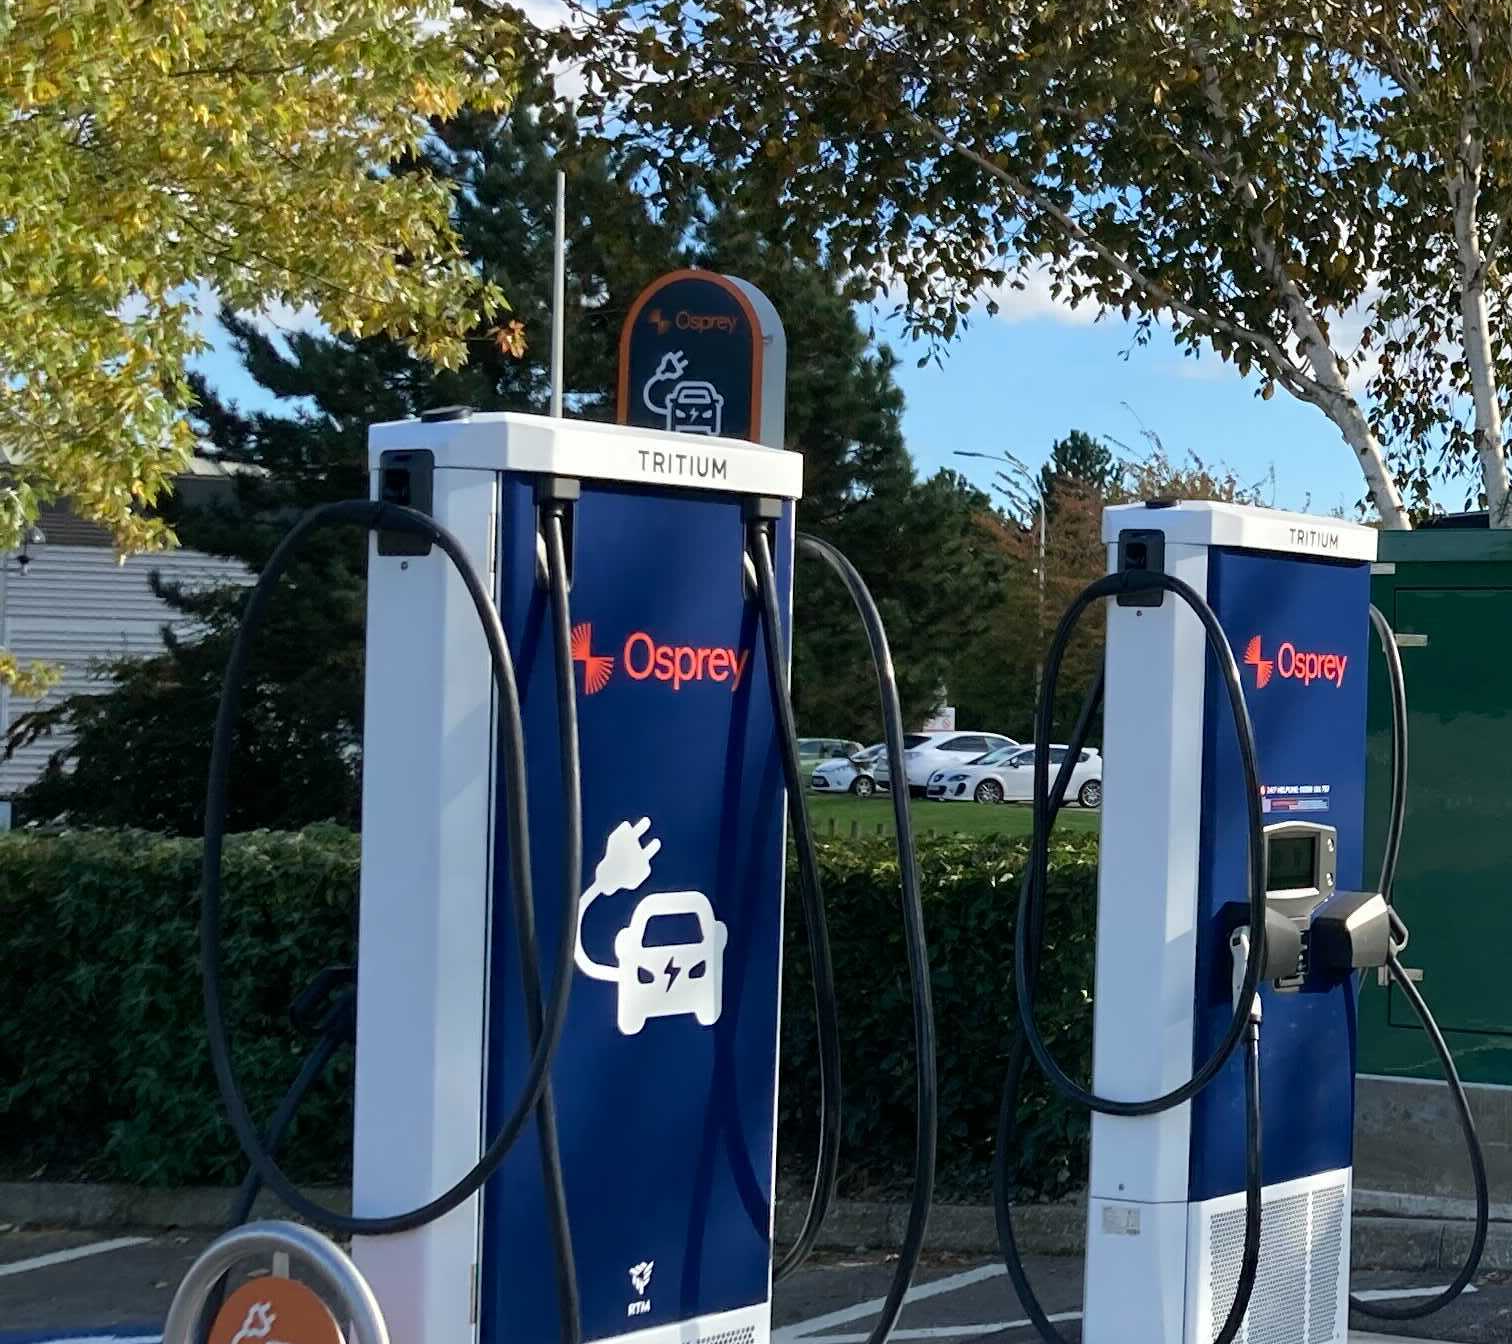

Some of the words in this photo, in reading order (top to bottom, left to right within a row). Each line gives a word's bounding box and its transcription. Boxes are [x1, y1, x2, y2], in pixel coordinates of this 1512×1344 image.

[675, 310, 738, 335] Osprey
[638, 450, 728, 481] TRITIUM
[1289, 528, 1339, 550] TRITIUM
[624, 631, 751, 692] Osprey
[1277, 641, 1347, 688] Osprey
[627, 1299, 651, 1316] RTM
